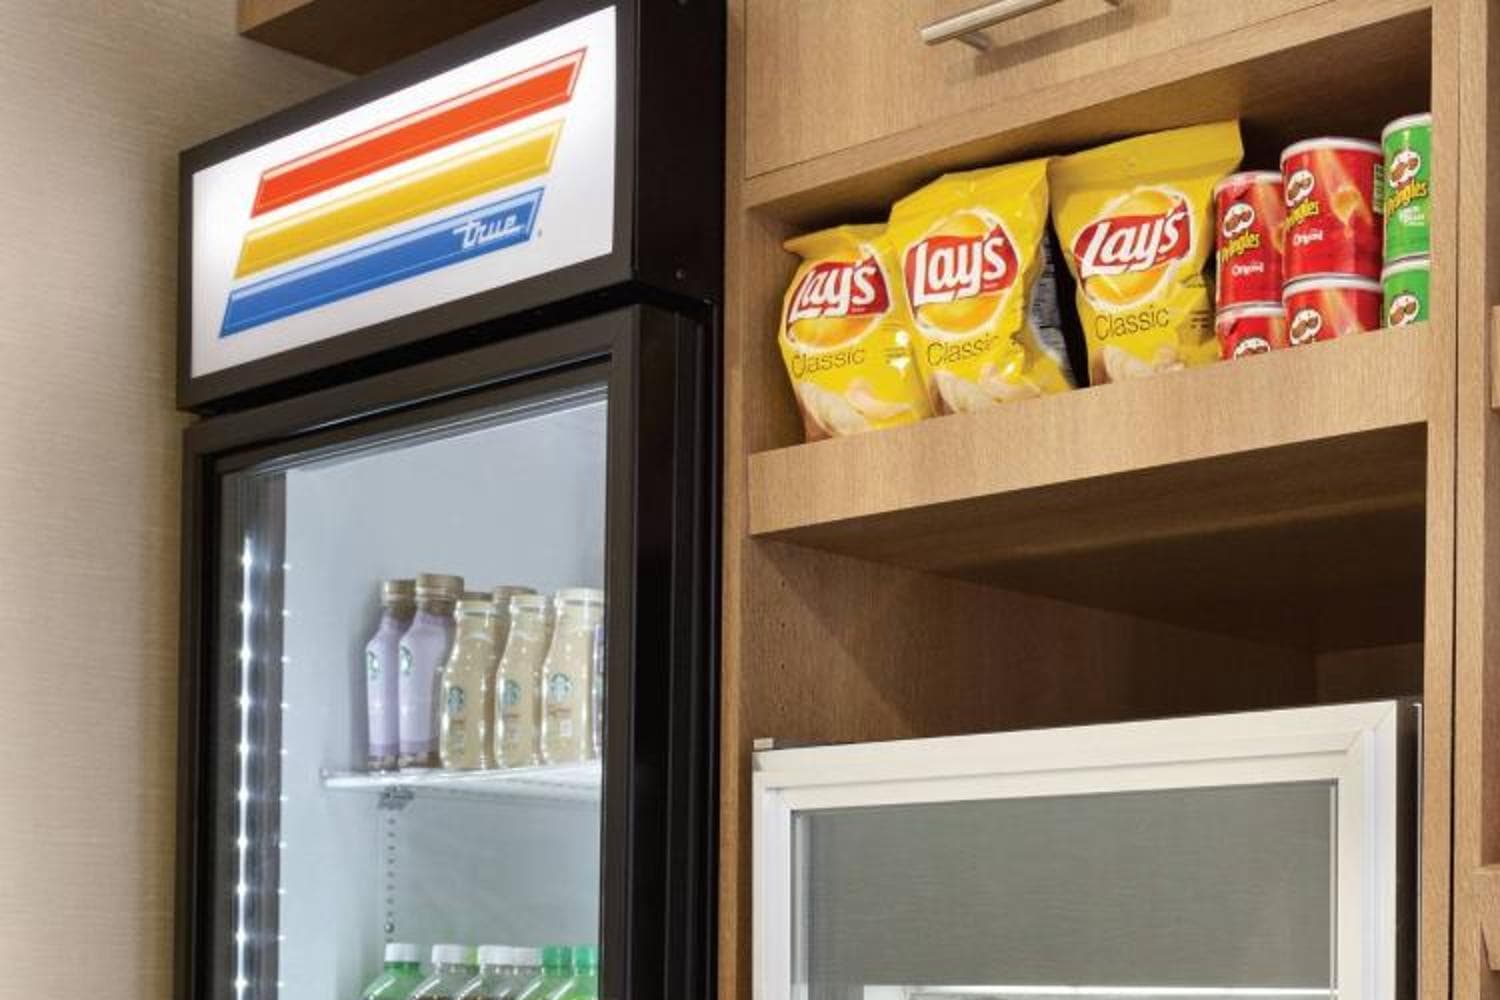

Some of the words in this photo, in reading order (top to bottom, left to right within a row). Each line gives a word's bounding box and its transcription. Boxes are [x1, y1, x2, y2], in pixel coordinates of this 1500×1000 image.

[912, 236, 1006, 308] Lay's
[1081, 211, 1189, 280] Lay's
[1095, 304, 1169, 341] Classic
